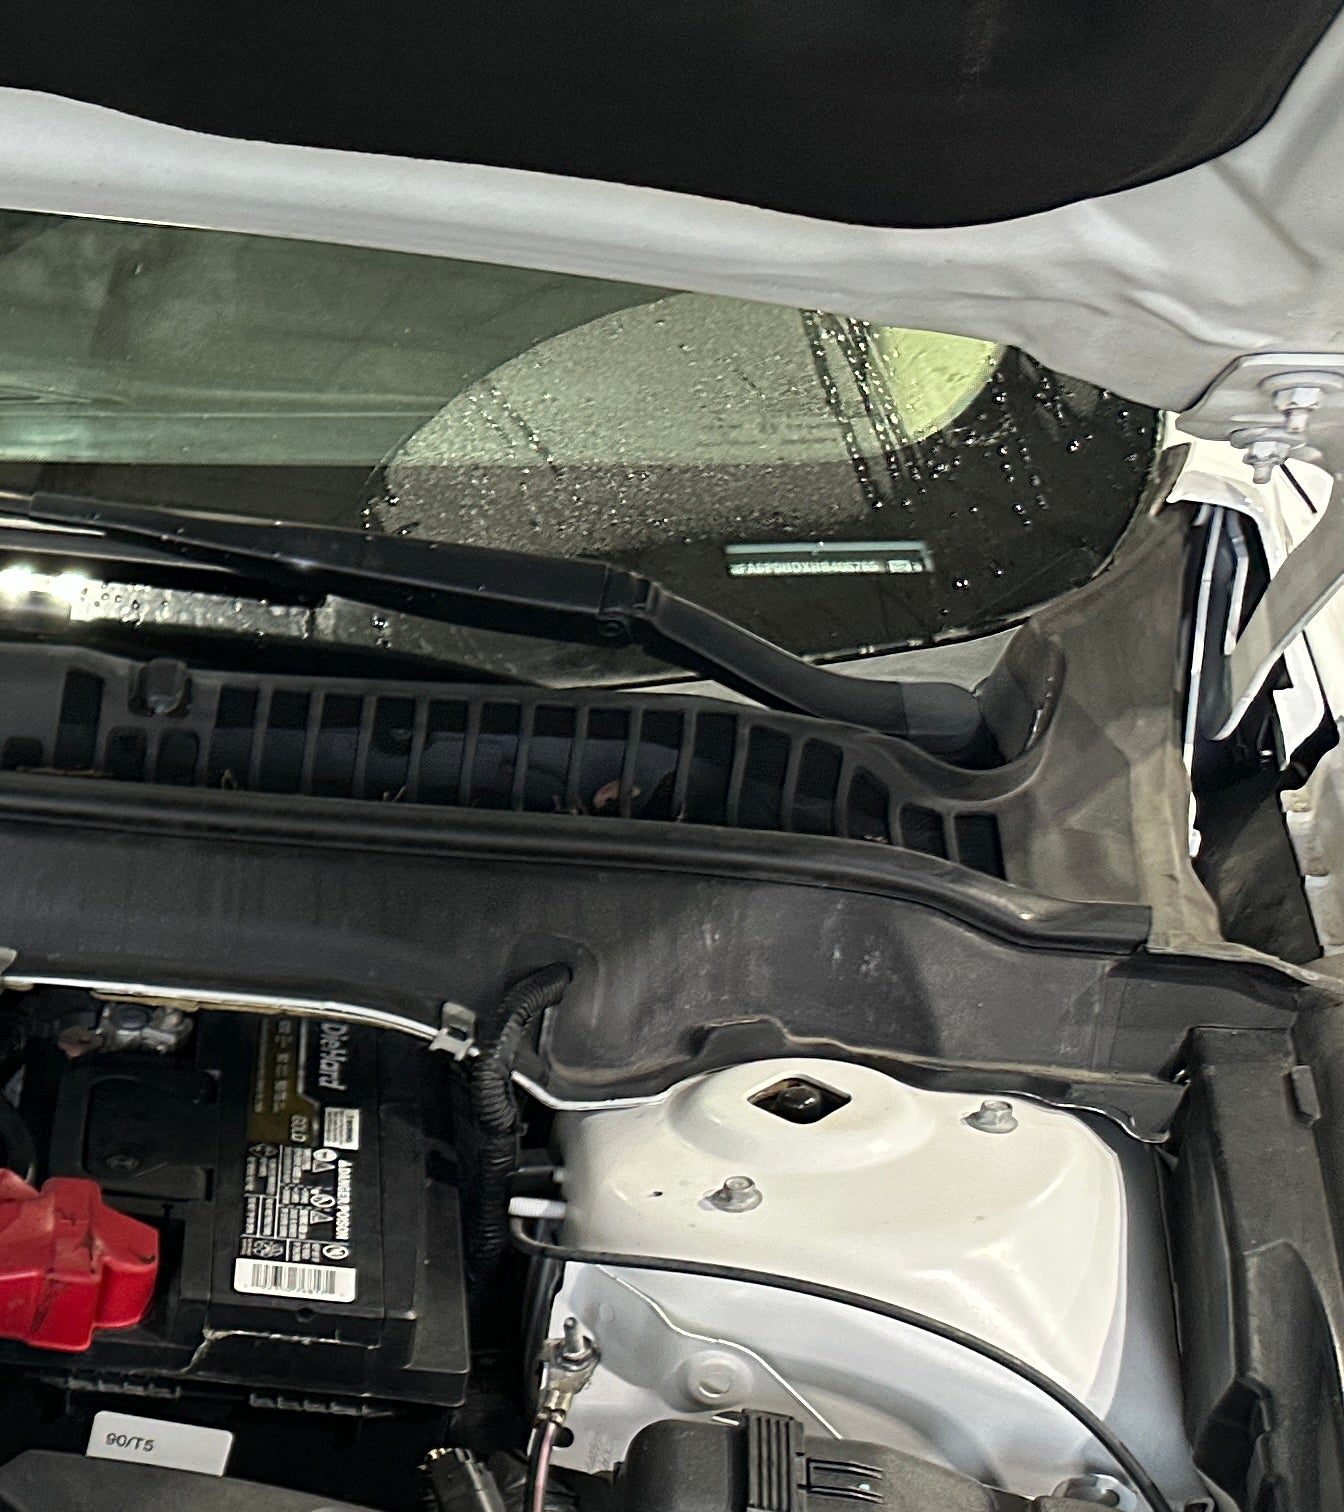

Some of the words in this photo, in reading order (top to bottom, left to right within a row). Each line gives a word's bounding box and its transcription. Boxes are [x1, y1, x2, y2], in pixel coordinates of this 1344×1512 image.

[318, 1022, 349, 1091] DieHard
[290, 1114, 308, 1143] GOLD
[106, 1431, 155, 1452] 90/T5
